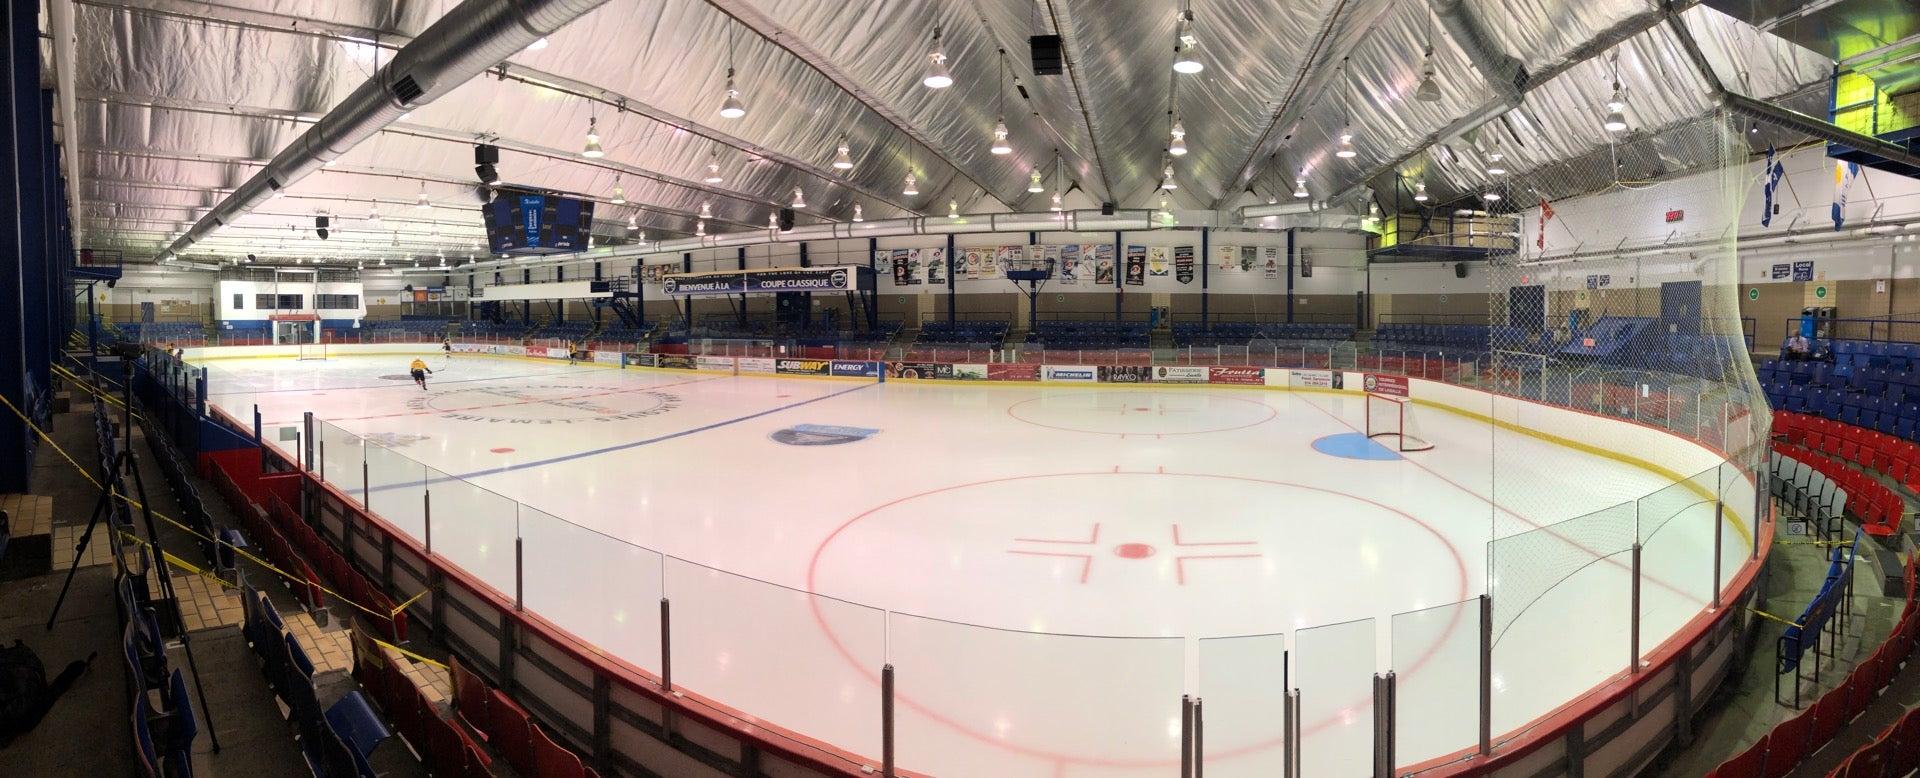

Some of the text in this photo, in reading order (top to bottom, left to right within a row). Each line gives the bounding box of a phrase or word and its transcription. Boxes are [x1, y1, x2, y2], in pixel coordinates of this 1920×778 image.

[679, 283, 714, 291] BIENVENUE
[721, 282, 730, 290] LA
[761, 279, 829, 288] COUPE CLASSIQUE
[777, 360, 827, 370] SUBWAY
[834, 363, 864, 371] ENERGY
